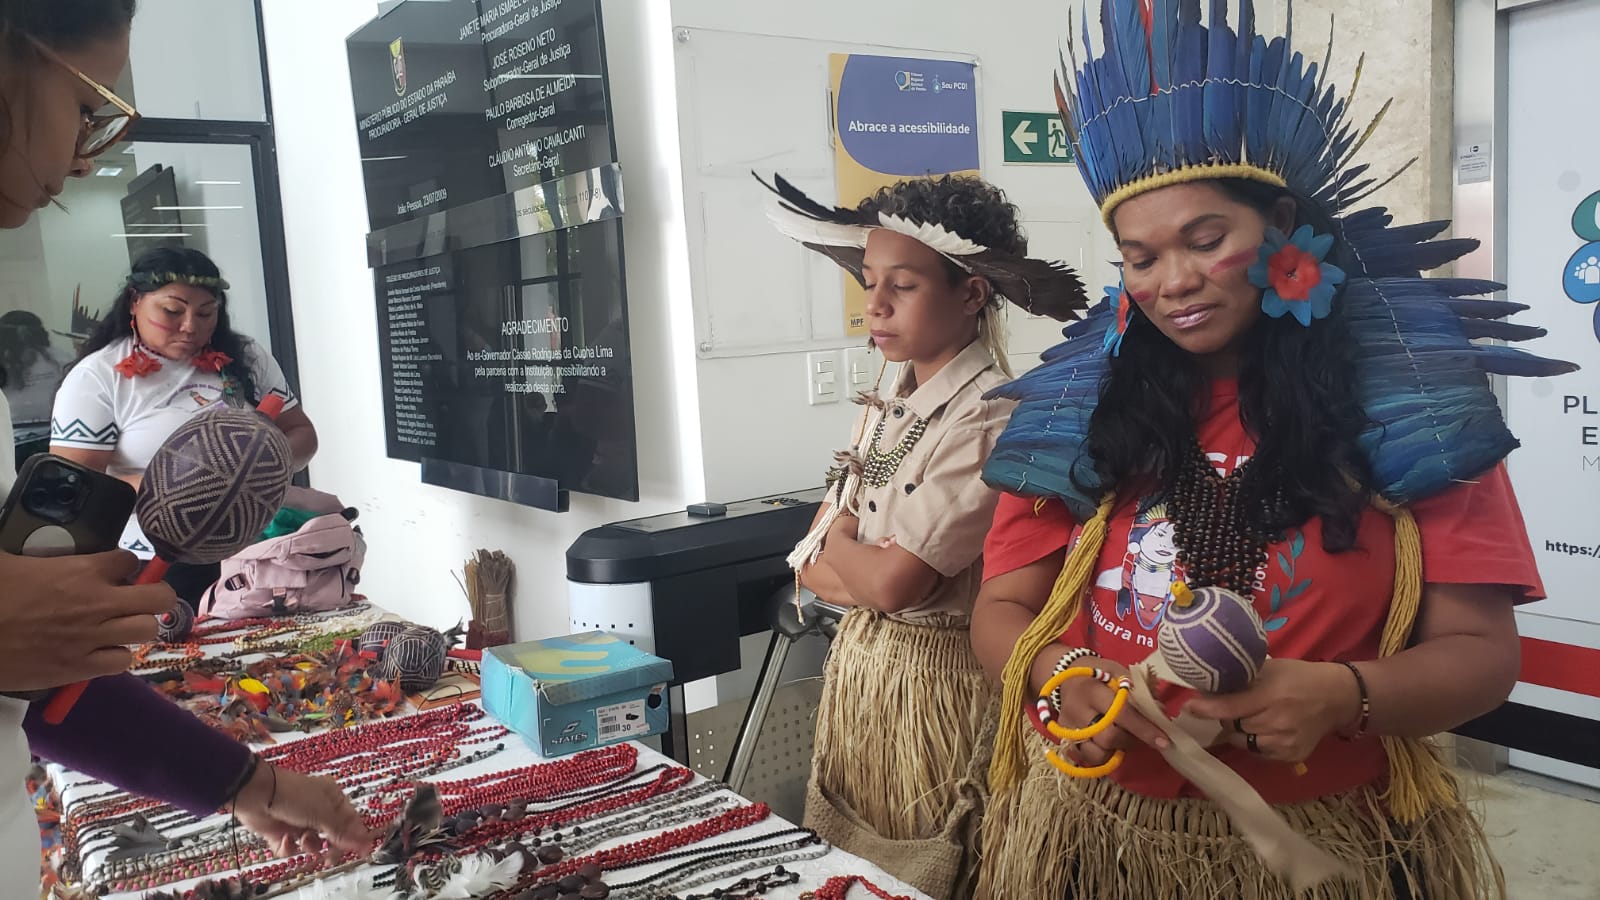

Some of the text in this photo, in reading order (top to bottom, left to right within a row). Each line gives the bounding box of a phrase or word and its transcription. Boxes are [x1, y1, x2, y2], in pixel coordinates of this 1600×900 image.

[459, 0, 521, 40] JANETE MARIA ISMAEL
[481, 11, 530, 44] Procuradora-Geral
[531, 5, 539, 18] de
[540, 0, 561, 14] Justiça
[492, 27, 556, 69] JOSÉ ROSENO NETO
[540, 52, 548, 65] de
[549, 42, 571, 62] Justiça
[407, 87, 426, 106] ESTADO
[426, 83, 435, 96] DA
[941, 81, 953, 89] Sou
[418, 102, 427, 116] DE
[426, 92, 448, 112] JUSTIÇA
[485, 74, 577, 122] PAULO BARBOSA DE ALMEIDA
[506, 102, 556, 130] Corregedor-Geral
[848, 120, 970, 134] Abrace a acessibilidade
[543, 125, 586, 150] CAVALCANTI
[513, 152, 560, 177] Secretário-Geral
[501, 316, 569, 336] AGRADECIMENTO
[850, 318, 864, 326] MPF
[466, 350, 474, 360] Ao
[474, 349, 511, 360] ex-Governador
[531, 347, 562, 362] Rodrigues
[562, 347, 572, 359] da
[595, 345, 613, 359] Lima
[474, 365, 486, 378] pela
[507, 367, 519, 376] com
[519, 367, 525, 376] a
[556, 364, 600, 380] possibilitando
[600, 366, 606, 376] a
[504, 381, 567, 395] realização desta obra.
[1563, 395, 1598, 414] PL
[1582, 426, 1598, 445] E
[1136, 633, 1154, 648] na
[622, 723, 631, 732] 30
